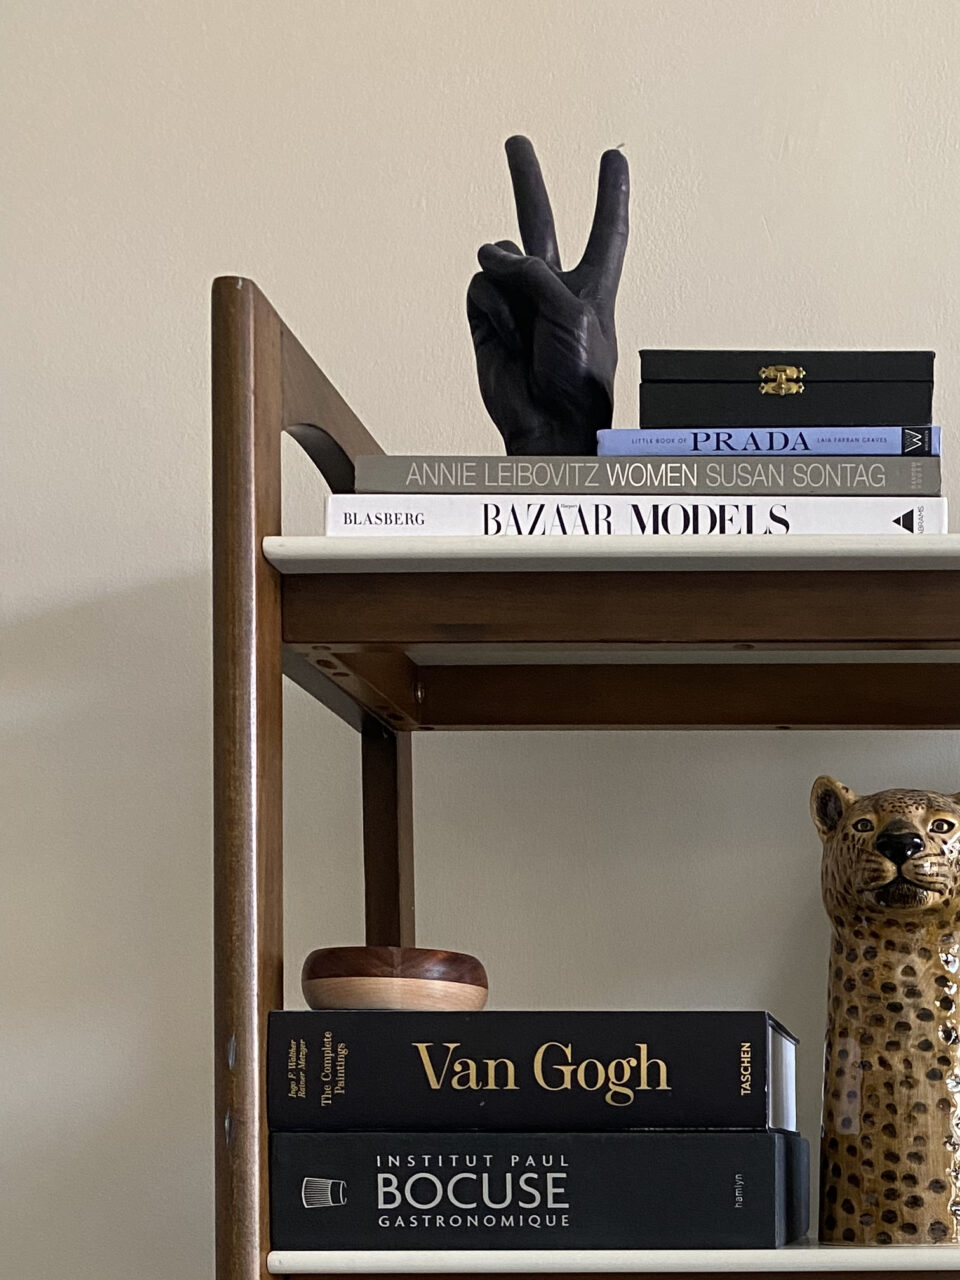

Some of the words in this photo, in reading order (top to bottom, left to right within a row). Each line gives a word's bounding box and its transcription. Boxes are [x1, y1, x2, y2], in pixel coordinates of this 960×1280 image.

[690, 431, 812, 451] PRADA
[405, 462, 476, 486] ANNIE
[484, 462, 600, 486] LEIBOVITZ
[606, 462, 697, 487] WOMEN
[705, 463, 784, 487] SUSAN
[792, 463, 886, 487] SONTAG
[343, 511, 425, 526] BLASBERG
[482, 503, 613, 535] BAZAAR
[629, 503, 790, 535] MODELS
[288, 1039, 297, 1069] Walther
[297, 1039, 308, 1070] Metzger
[320, 1031, 335, 1081] Complete
[334, 1042, 349, 1094] Paintings
[740, 1042, 751, 1096] TASCHEN
[297, 1071, 306, 1098] Rainer
[411, 1042, 520, 1090] Van
[533, 1041, 672, 1106] Gogh
[288, 1081, 298, 1098] Ingo
[321, 1084, 332, 1107] The
[376, 1155, 494, 1167] INSTITUT
[511, 1155, 569, 1167] PAUL
[377, 1172, 570, 1210] BOCUSE
[734, 1173, 744, 1208] hamlyn
[378, 1214, 570, 1229] GASTRONOMIQUE
